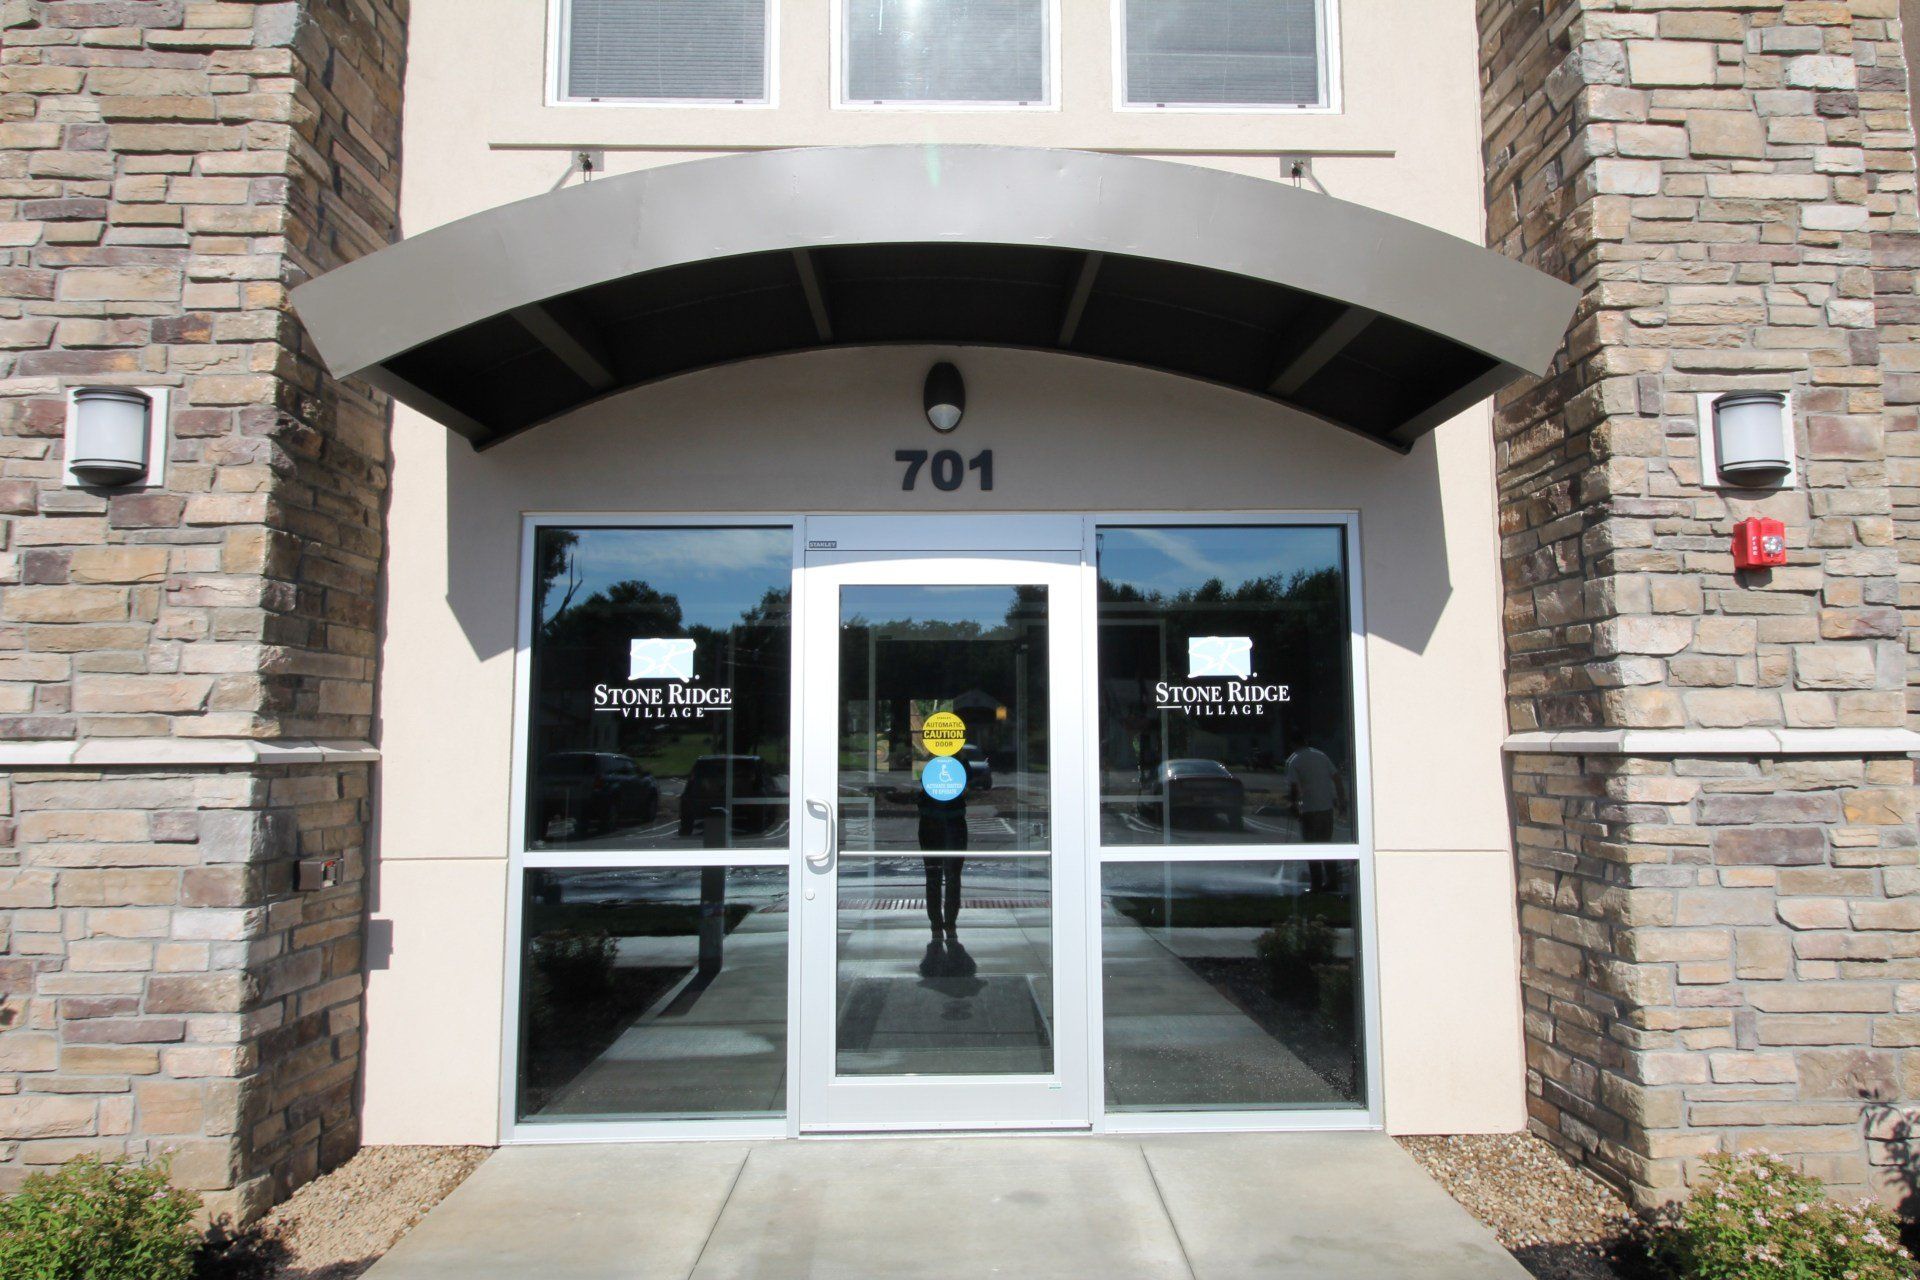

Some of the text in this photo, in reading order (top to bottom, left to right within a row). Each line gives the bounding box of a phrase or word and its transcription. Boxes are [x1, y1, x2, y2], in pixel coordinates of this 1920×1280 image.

[895, 450, 993, 491] 701
[594, 683, 732, 705] STONE RIDGE
[1155, 681, 1291, 703] STONE RIDGE
[622, 707, 705, 718] VILLAGE
[1184, 704, 1264, 715] VILLAGE
[923, 730, 964, 739] CAUTION
